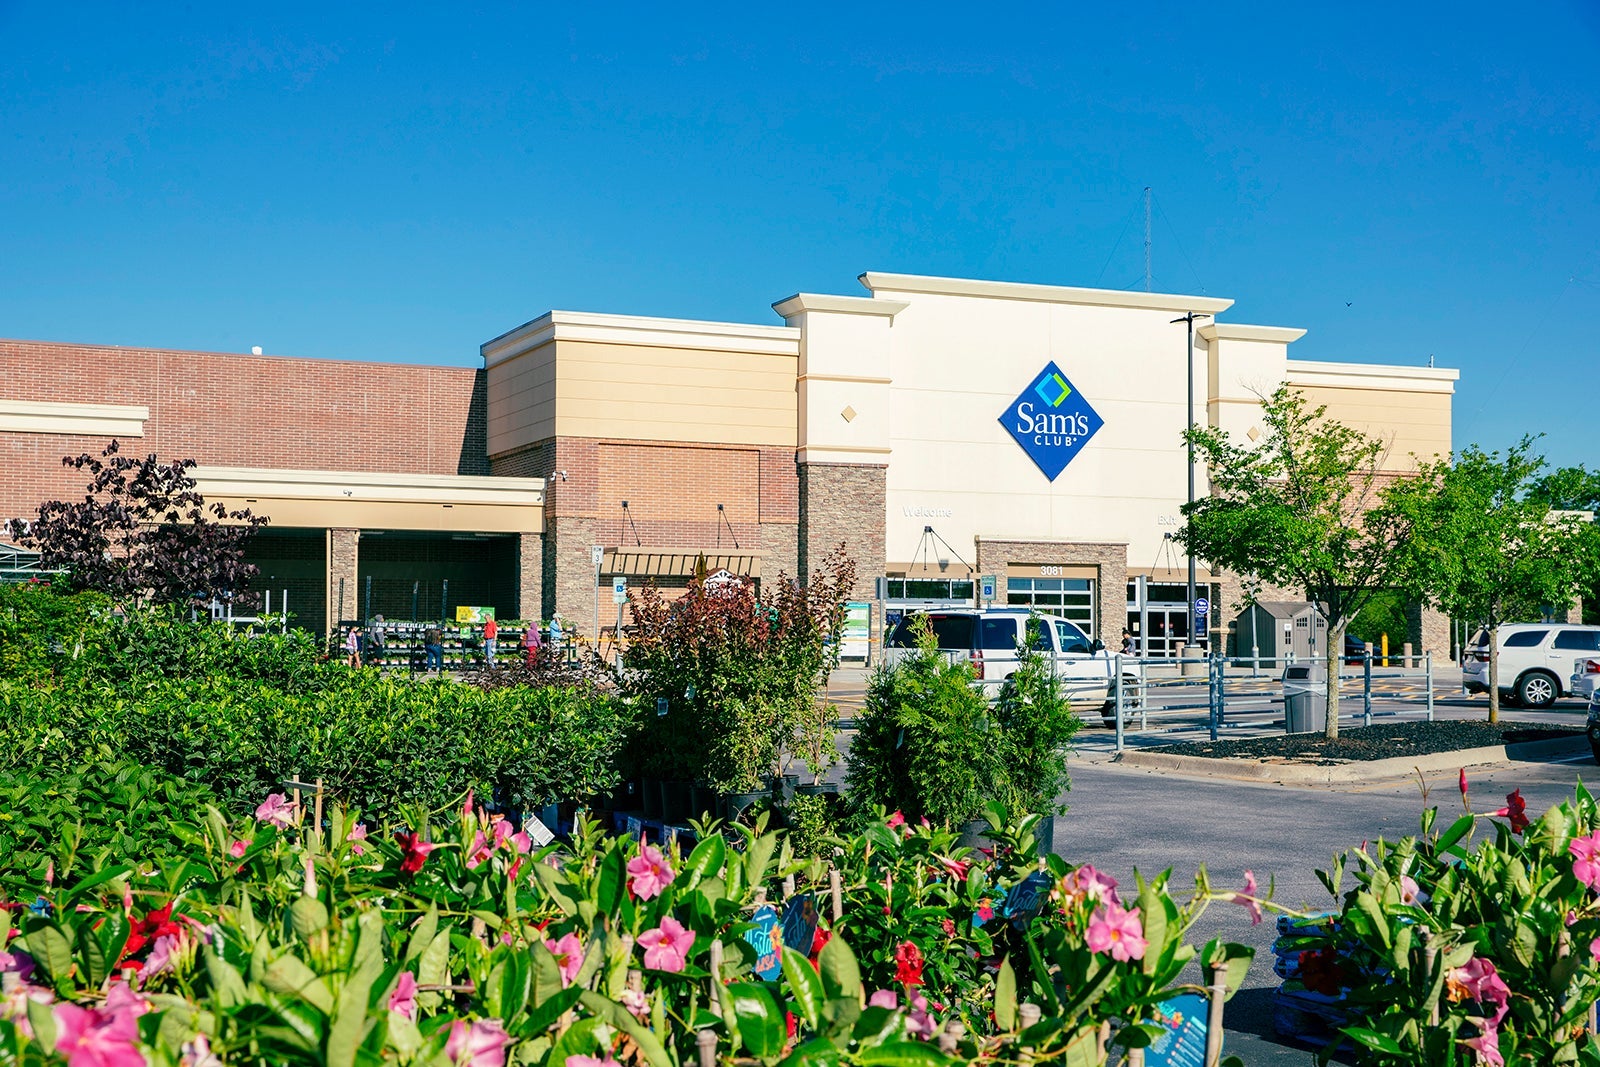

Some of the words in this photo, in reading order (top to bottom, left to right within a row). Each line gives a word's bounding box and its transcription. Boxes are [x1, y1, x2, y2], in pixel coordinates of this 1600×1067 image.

[1017, 402, 1089, 436] Sam's
[902, 504, 953, 518] Welcome
[1157, 513, 1177, 526] Exit
[1040, 565, 1063, 576] 3081
